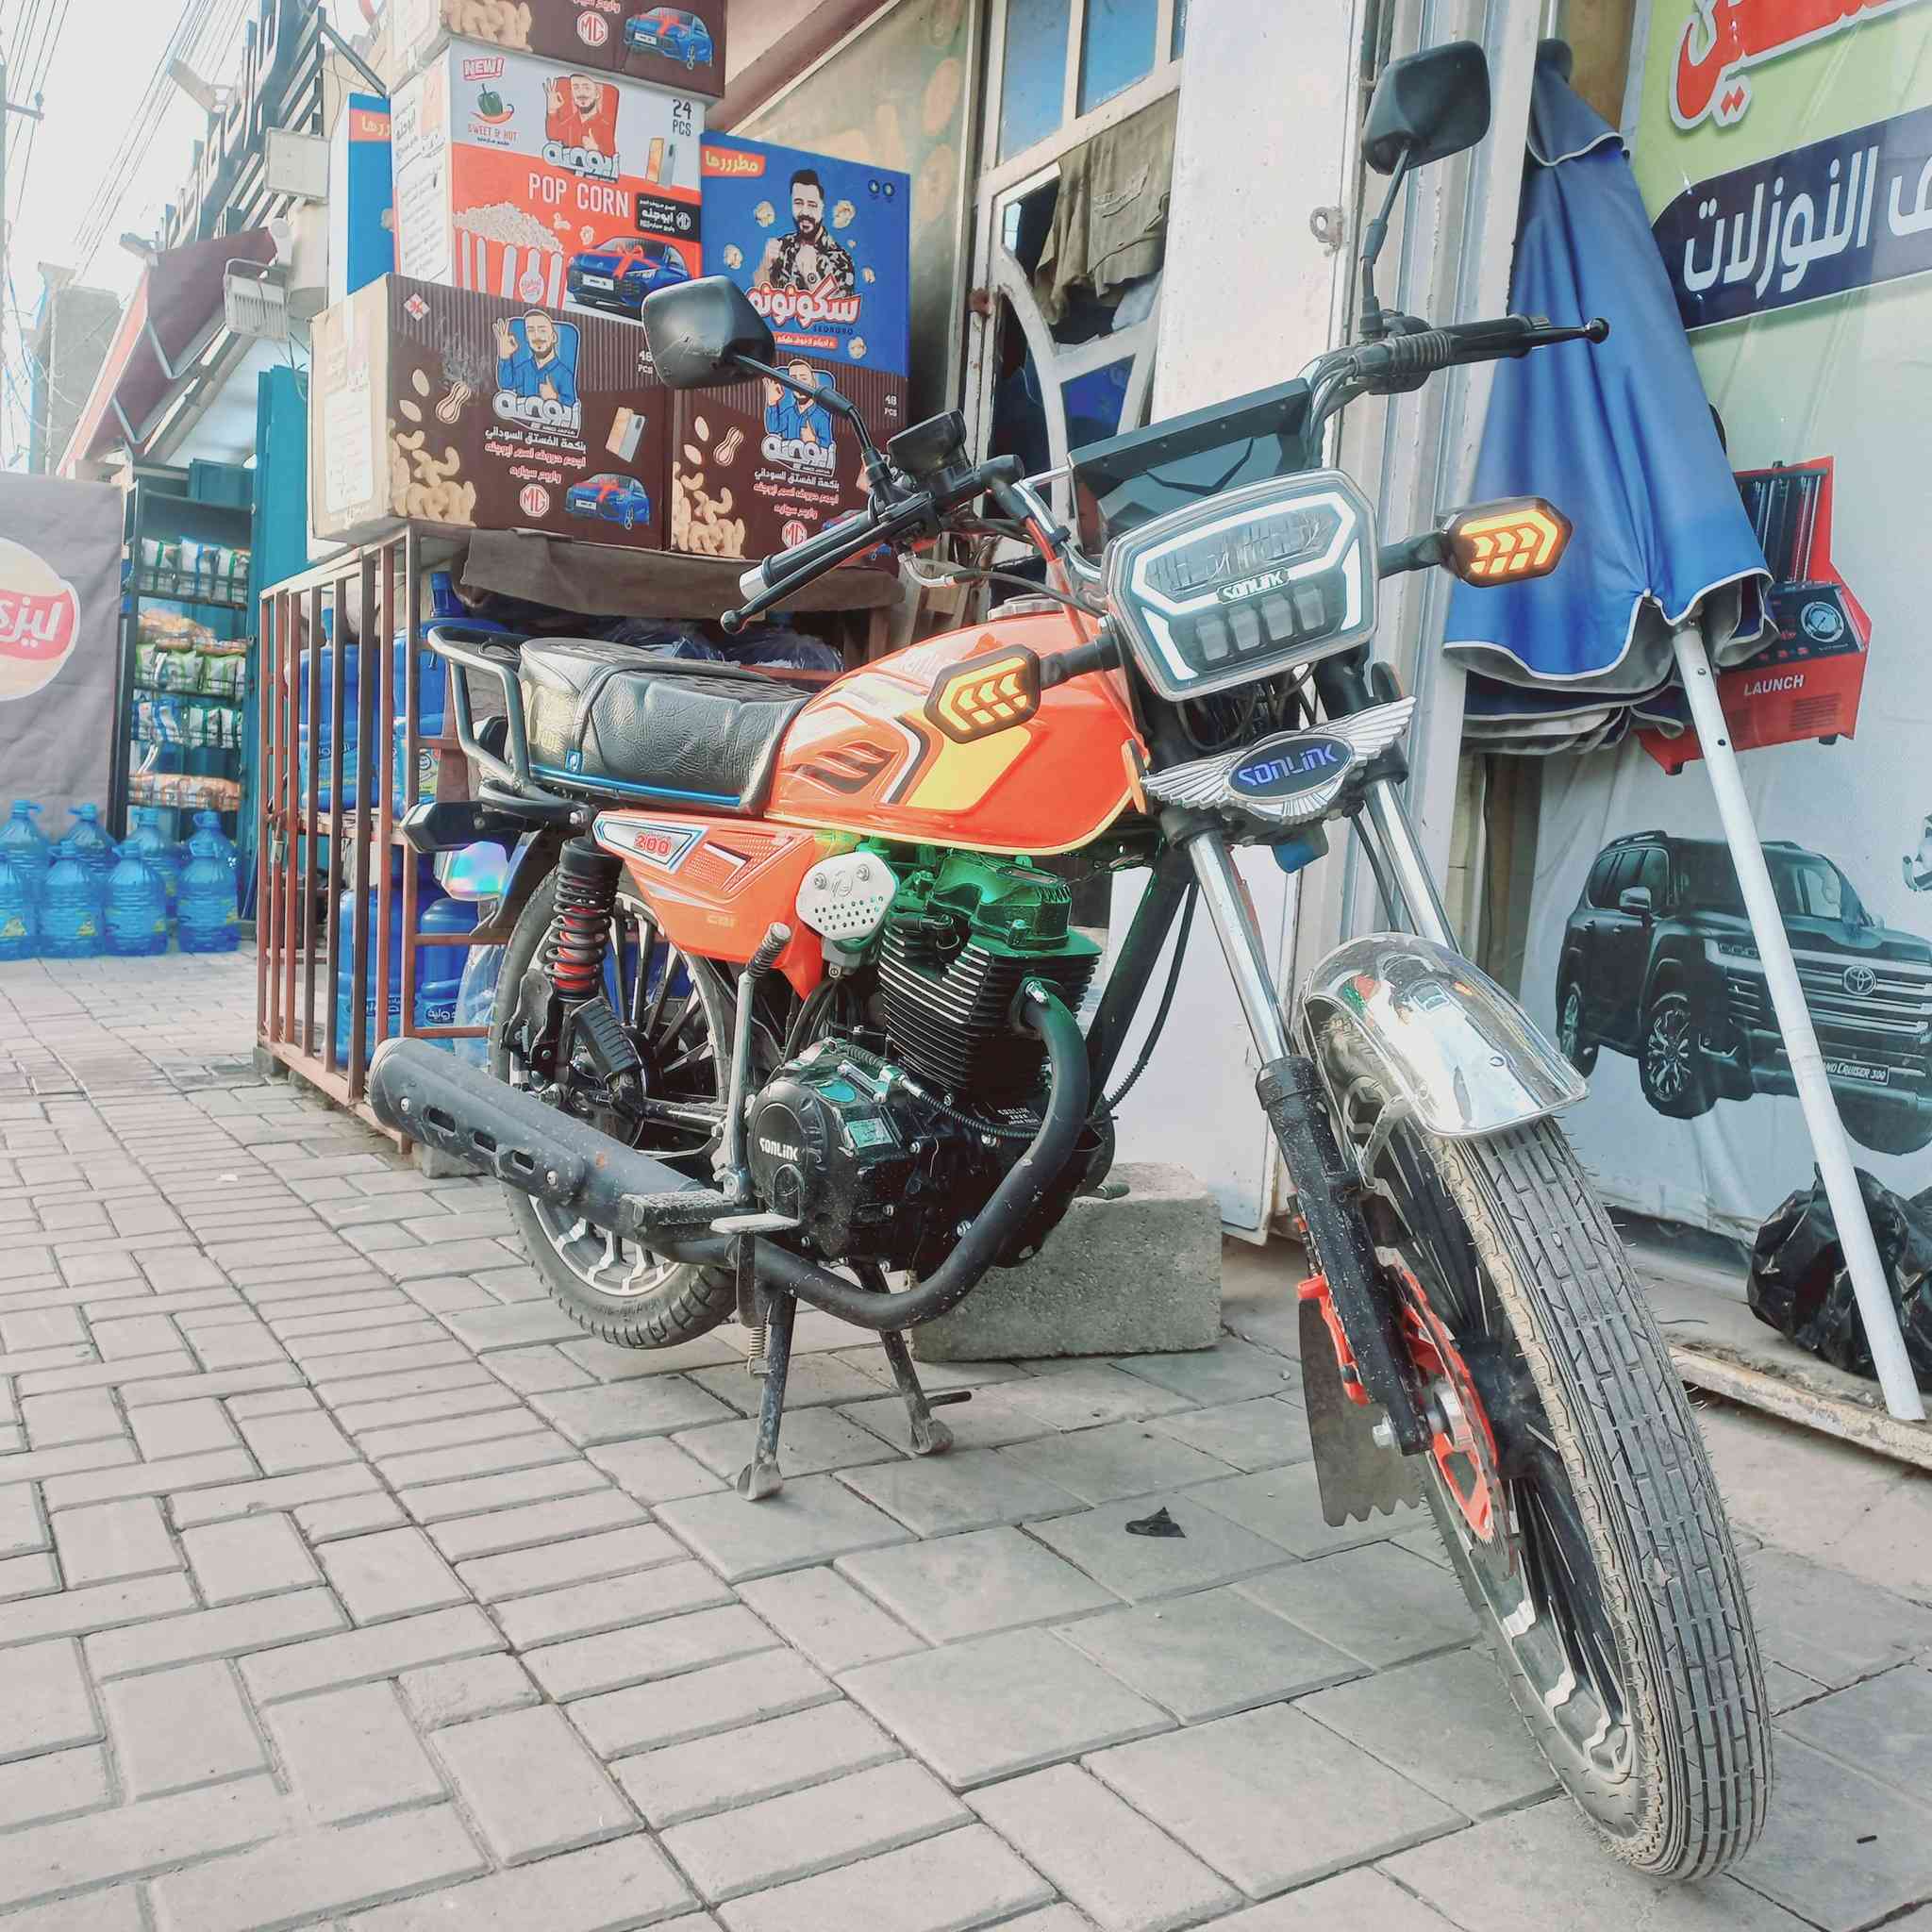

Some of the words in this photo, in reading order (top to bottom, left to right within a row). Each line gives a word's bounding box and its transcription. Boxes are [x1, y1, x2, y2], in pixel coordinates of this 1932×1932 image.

[463, 58, 505, 77] NEW!
[673, 99, 691, 120] 24
[673, 119, 691, 136] PCS
[528, 173, 566, 204] POP
[577, 183, 629, 218] CORN
[1683, 145, 1879, 299] النوزلات
[639, 350, 653, 362] 48
[885, 394, 897, 406] 48
[522, 486, 547, 515] MG
[1743, 674, 1805, 696] LAUNCH
[634, 832, 671, 857] 200
[1837, 1062, 1871, 1079] CRUISER
[1870, 1069, 1886, 1081] 300
